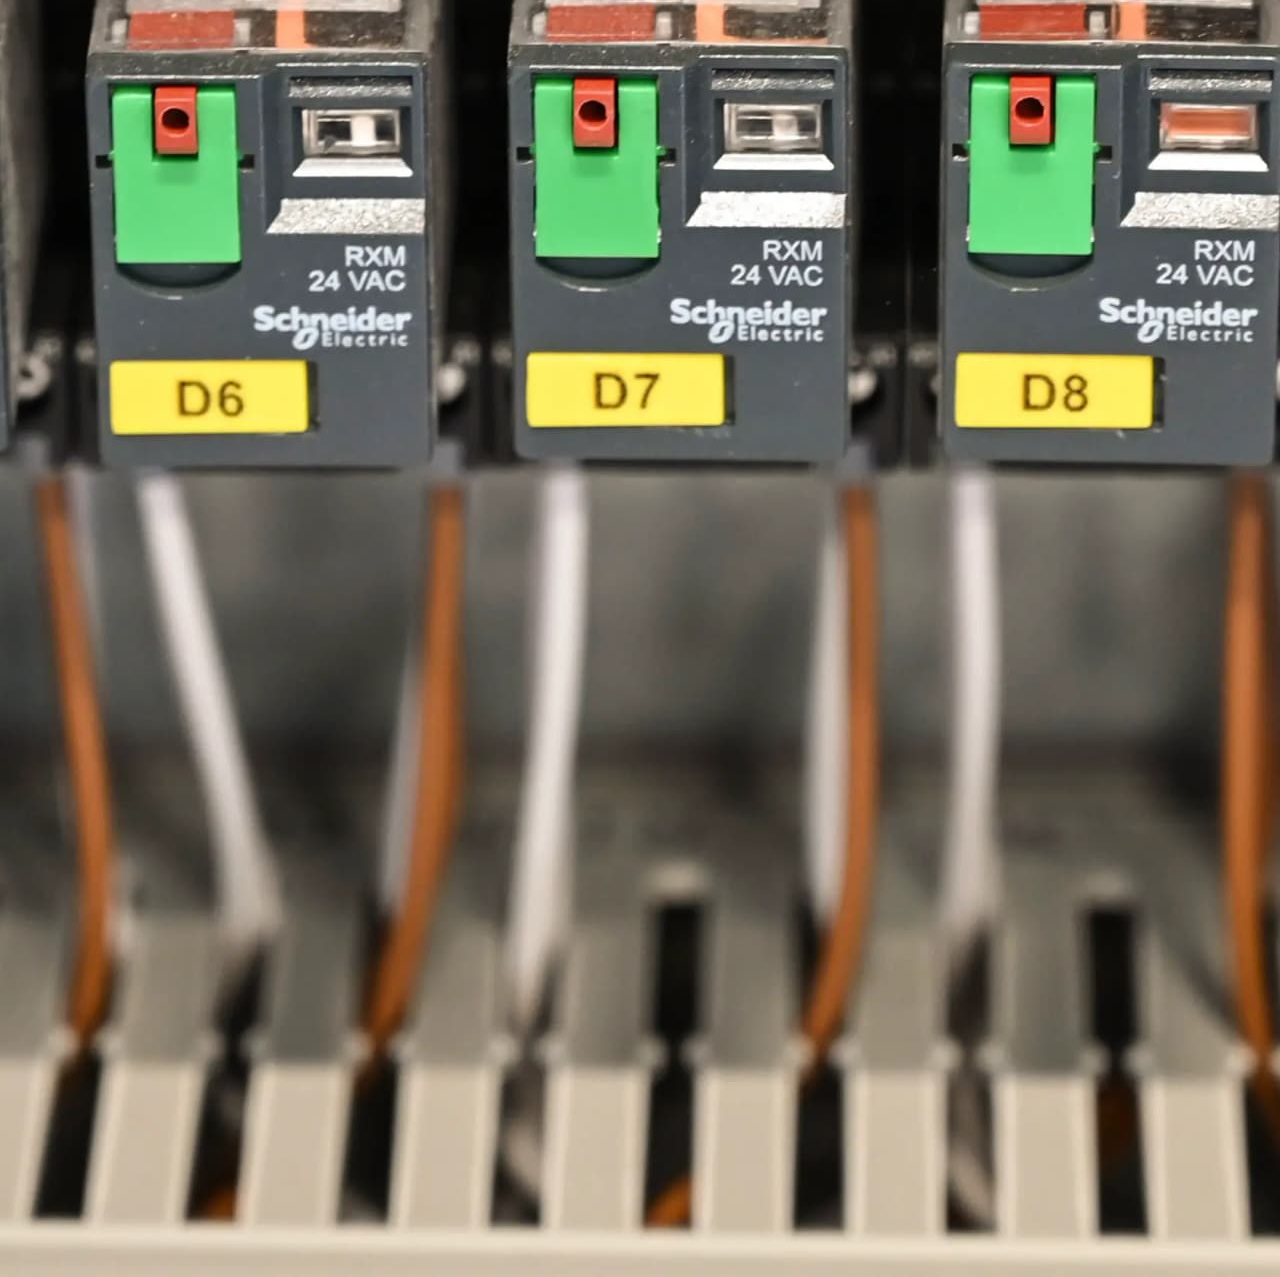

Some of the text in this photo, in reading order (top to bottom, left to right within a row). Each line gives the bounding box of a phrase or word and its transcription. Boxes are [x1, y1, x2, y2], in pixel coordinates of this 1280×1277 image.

[345, 246, 405, 266] RXM
[763, 240, 822, 261] RXM
[1195, 240, 1255, 261] RXM
[309, 270, 406, 291] 24 VAC
[731, 264, 823, 286] 24 VAC
[1156, 263, 1254, 286] 24 VAC
[254, 306, 412, 332] Schneider
[670, 298, 827, 325] Schneider
[1099, 298, 1258, 325] Schneider
[322, 329, 407, 347] Electric
[738, 323, 823, 341] Electric
[1167, 322, 1252, 342] Electric
[177, 381, 244, 417] D6
[594, 372, 659, 409] D7
[1023, 374, 1088, 412] D8
